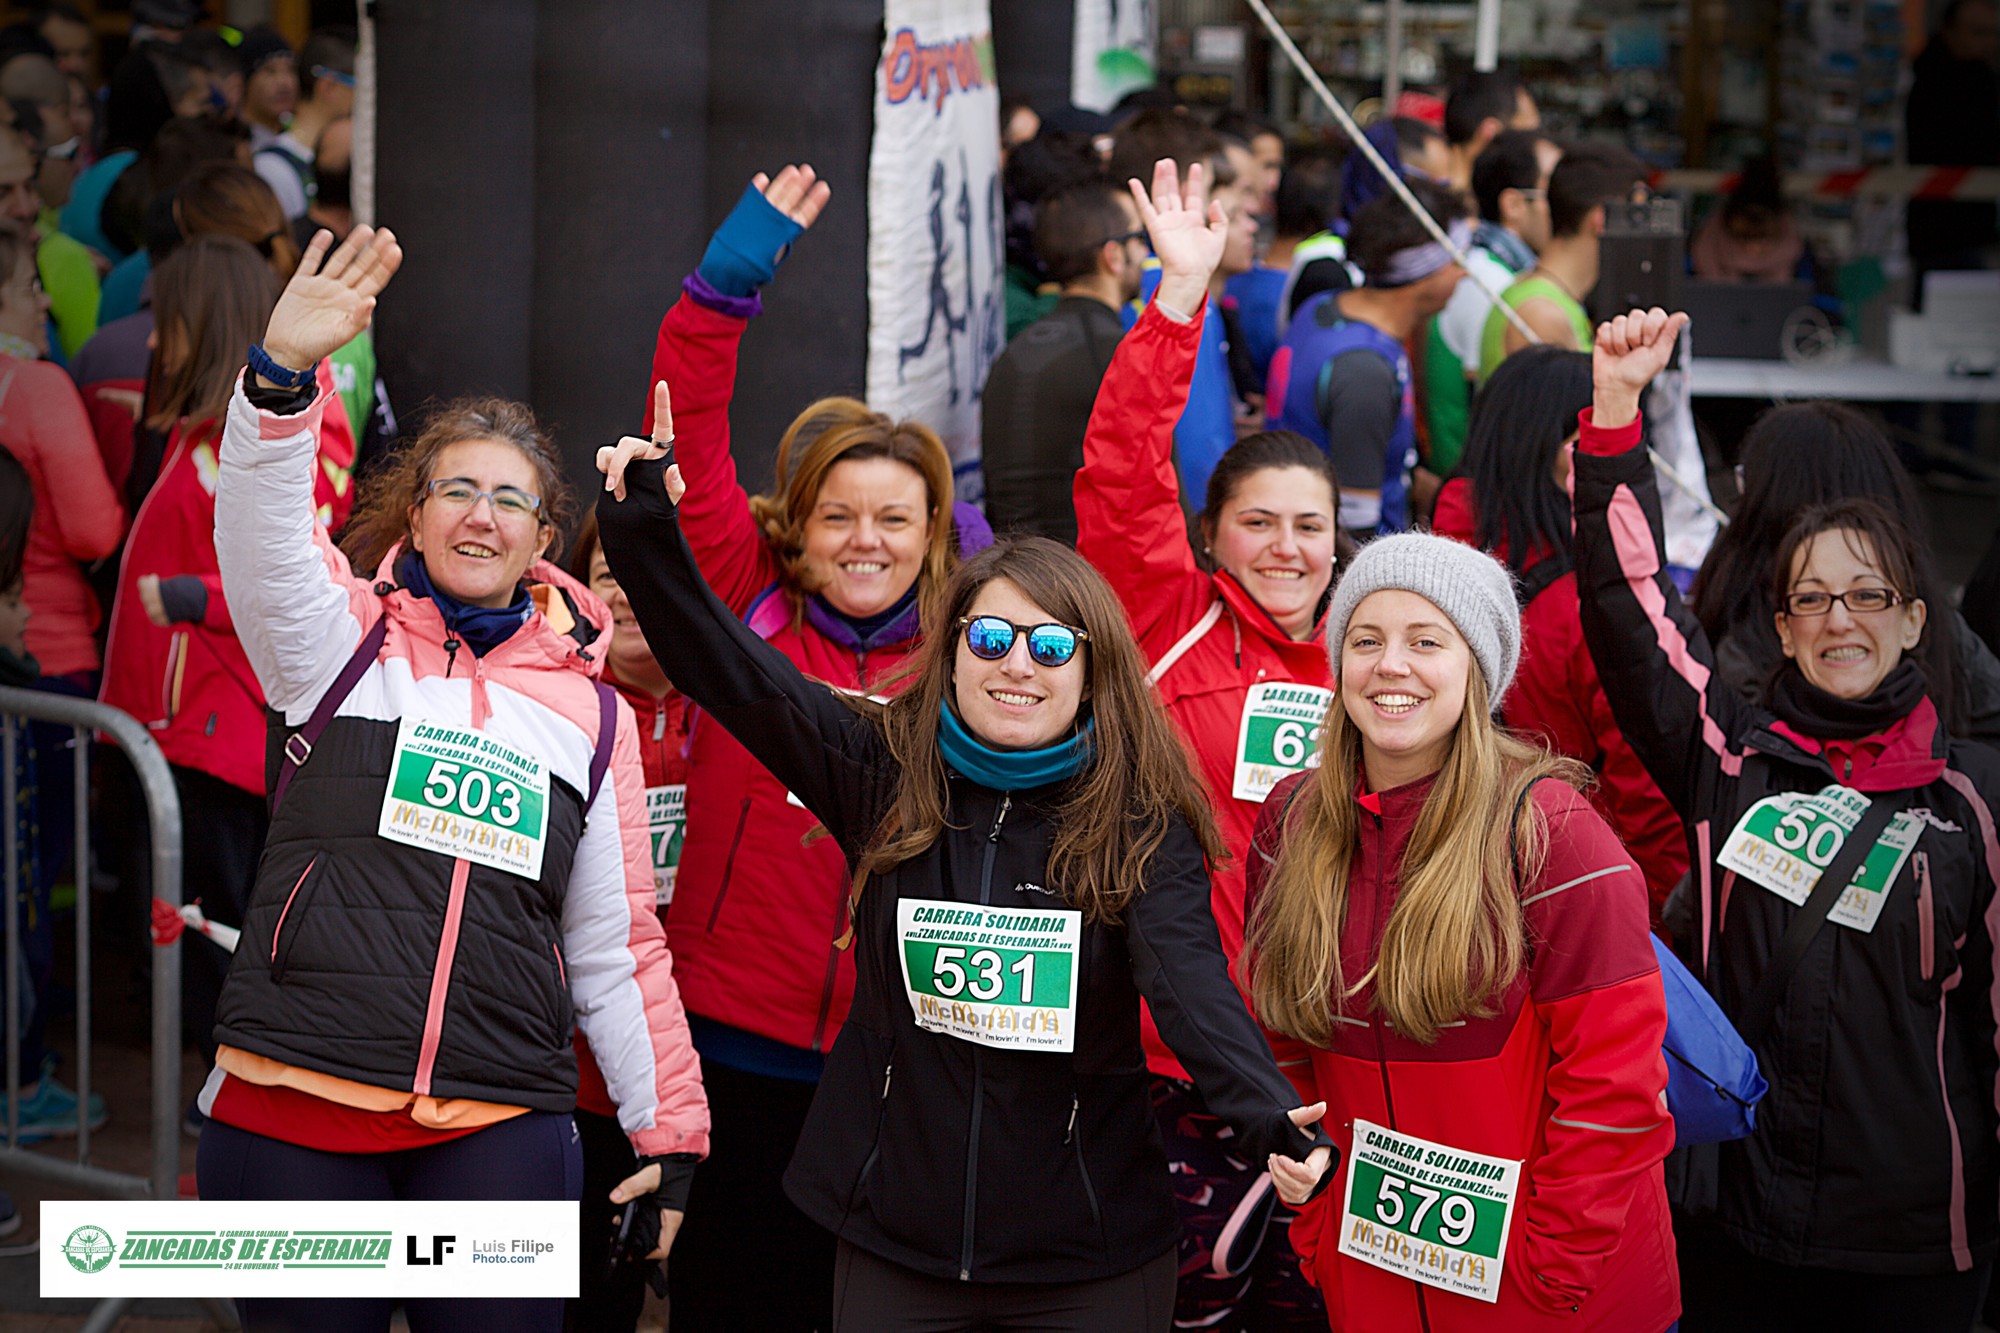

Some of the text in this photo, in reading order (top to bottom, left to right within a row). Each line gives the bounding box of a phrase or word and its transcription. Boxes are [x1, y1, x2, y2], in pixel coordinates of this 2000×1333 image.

[1262, 688, 1321, 706] CARRERA
[413, 724, 540, 775] CARRERA SOLIDARIA
[472, 755, 485, 766] DE
[422, 759, 522, 827] 503
[392, 803, 531, 860] McDonald's
[913, 907, 1067, 933] CARRERA SOLIDARIA
[978, 933, 991, 944] DE
[932, 946, 1036, 1004] 531
[919, 994, 1059, 1035] McDonald's
[995, 1034, 1014, 1043] lovin'
[1366, 1131, 1506, 1182] CARRERA SOLIDARIA
[1416, 1168, 1429, 1181] DE
[1375, 1173, 1477, 1247] 579
[1351, 1218, 1485, 1283] McDonald's
[1415, 1268, 1424, 1277] I'm
[1441, 1276, 1447, 1284] it
[1452, 1279, 1463, 1288] I'm
